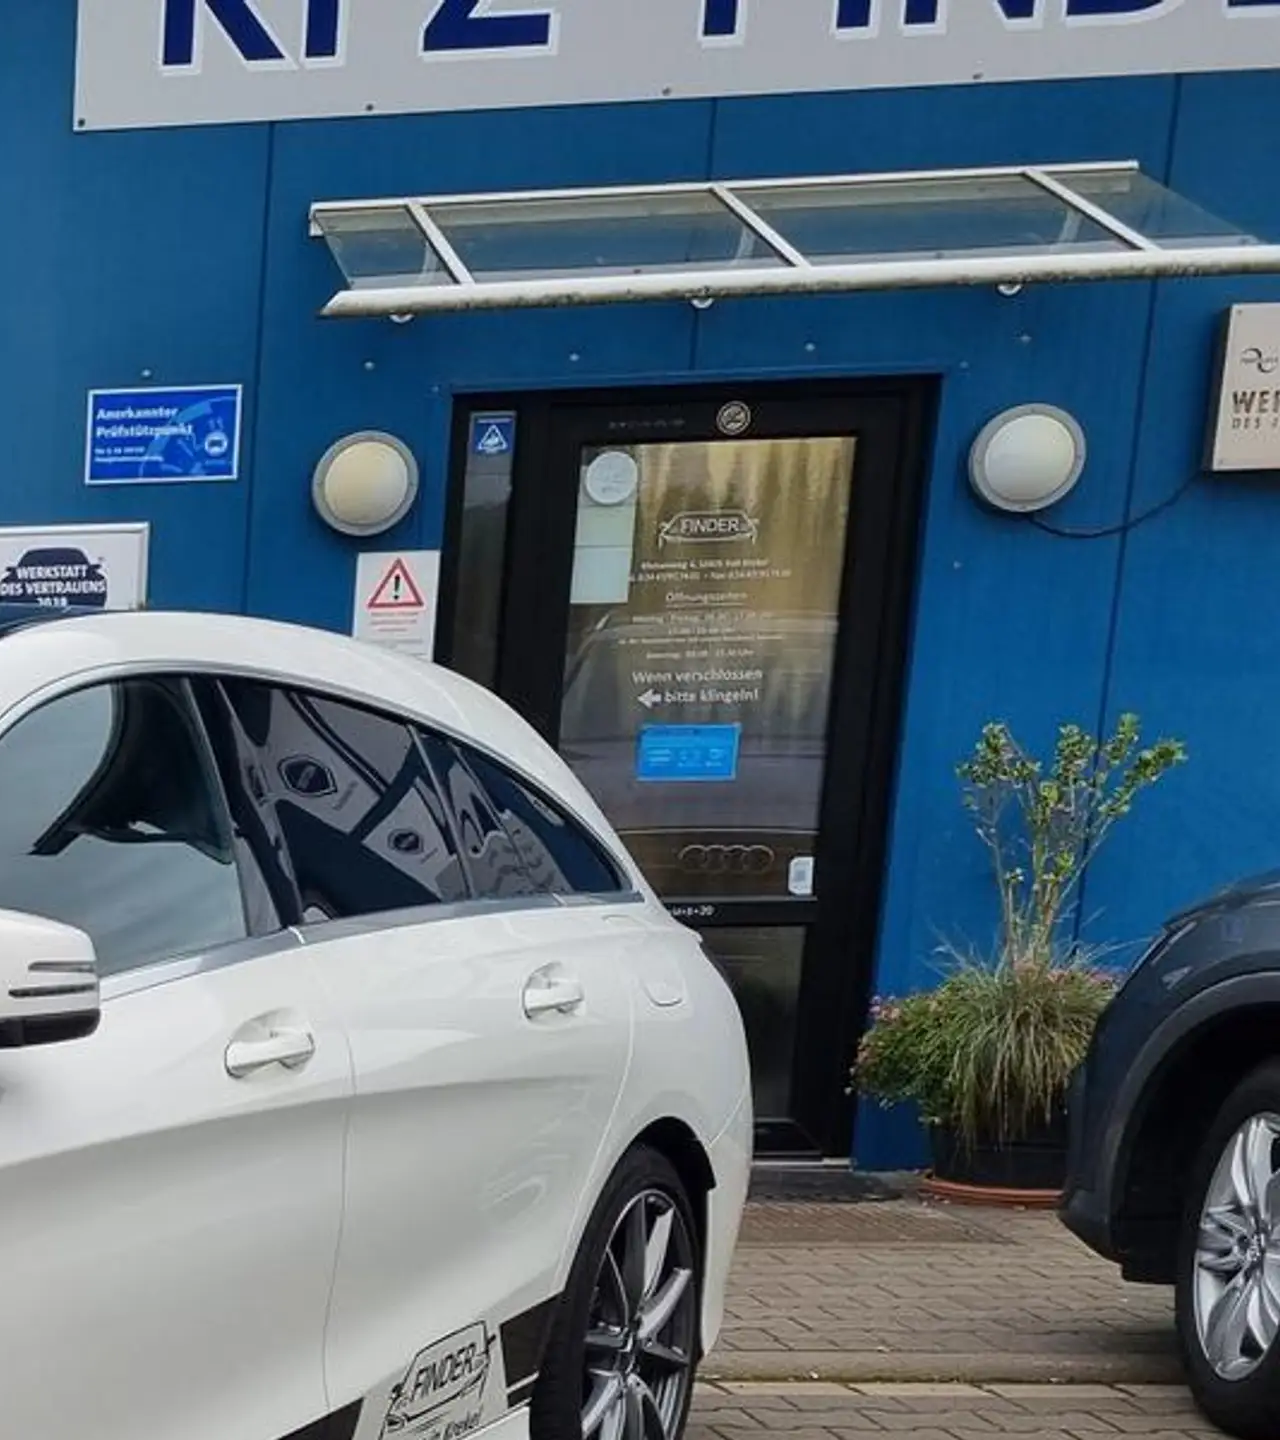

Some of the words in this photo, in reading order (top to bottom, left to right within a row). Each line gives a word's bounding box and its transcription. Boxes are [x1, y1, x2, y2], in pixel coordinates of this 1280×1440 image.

[680, 517, 740, 534] FINDER
[16, 565, 88, 579] WERKSTATT
[0, 582, 23, 595] DES
[25, 580, 106, 595] VERTRAUENS
[632, 671, 672, 684] Wenn
[674, 667, 763, 682] verschlossen
[664, 690, 697, 703] bitte
[411, 1342, 478, 1402] FINDER
